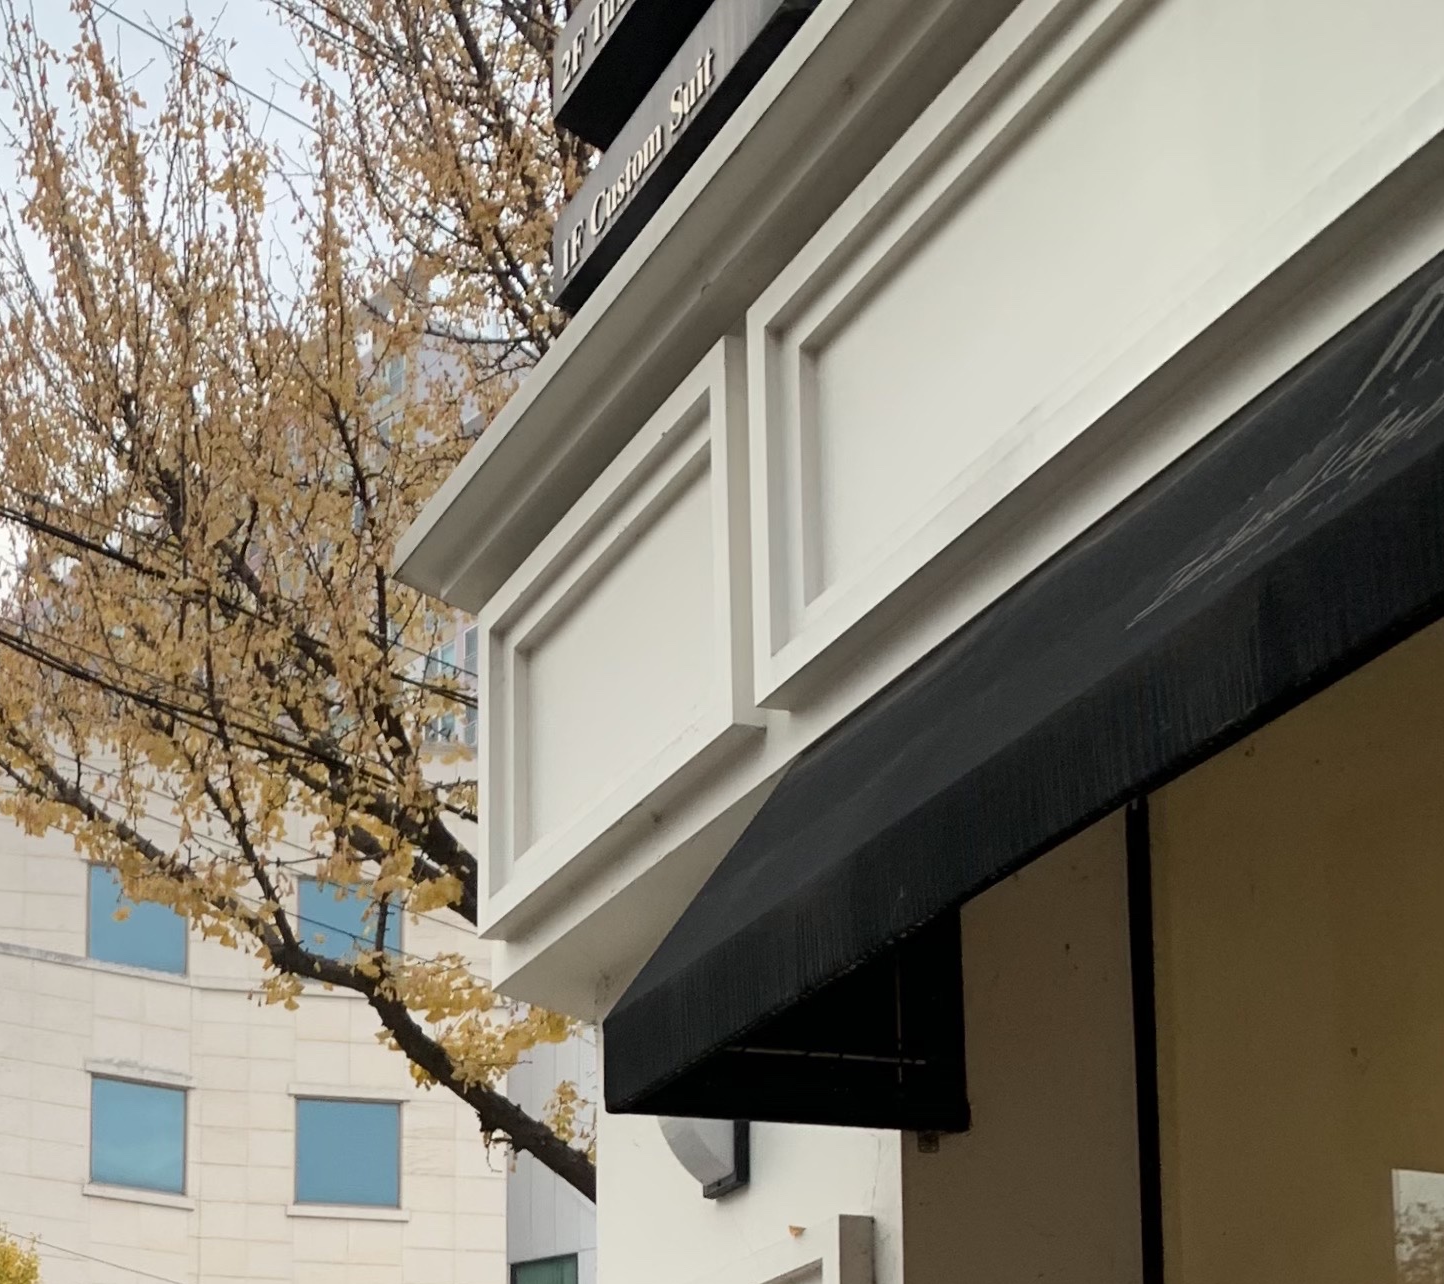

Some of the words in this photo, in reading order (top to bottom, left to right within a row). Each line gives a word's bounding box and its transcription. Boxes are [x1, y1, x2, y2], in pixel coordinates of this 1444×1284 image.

[560, 26, 587, 92] 2F
[561, 218, 586, 280] 1F
[589, 123, 664, 237] Custom
[669, 47, 717, 134] Suit
